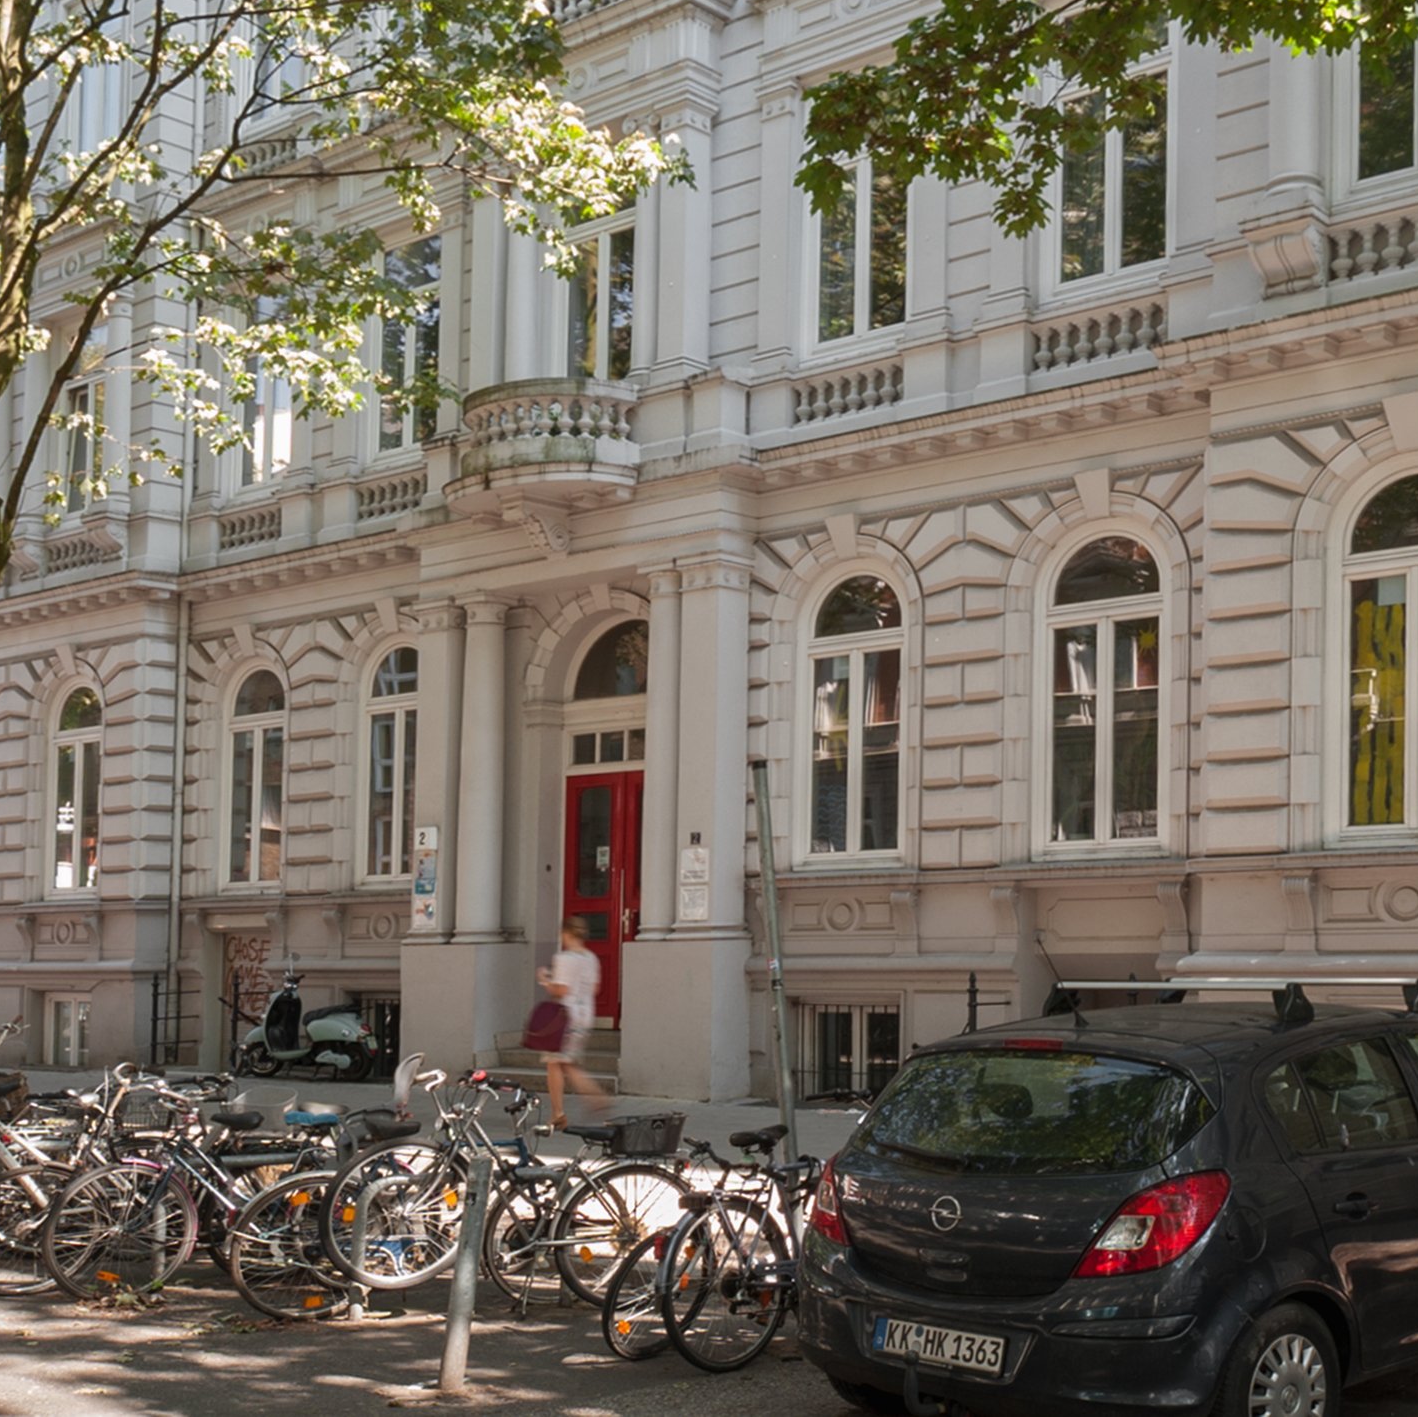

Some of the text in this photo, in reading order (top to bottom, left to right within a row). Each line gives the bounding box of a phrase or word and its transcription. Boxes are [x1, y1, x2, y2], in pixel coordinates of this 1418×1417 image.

[419, 831, 427, 846] 2
[227, 936, 271, 965] CHOSE
[886, 1322, 1002, 1368] KK HK 1363
